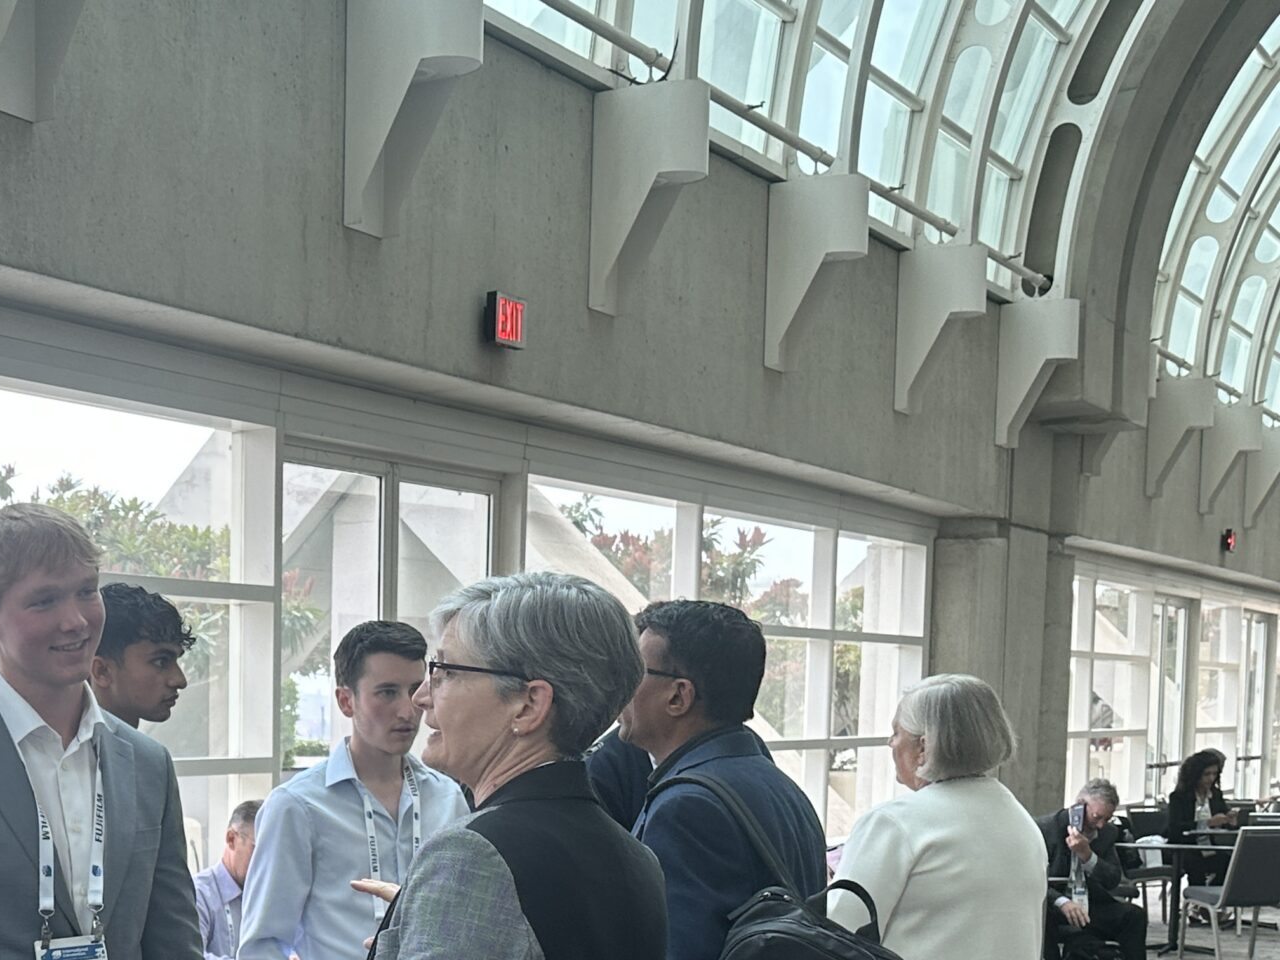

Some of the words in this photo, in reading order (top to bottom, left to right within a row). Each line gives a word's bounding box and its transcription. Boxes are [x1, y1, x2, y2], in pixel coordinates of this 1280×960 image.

[498, 297, 525, 342] EXIT
[95, 793, 103, 842] FUJIFILM
[369, 836, 378, 872] FUJIFILM
